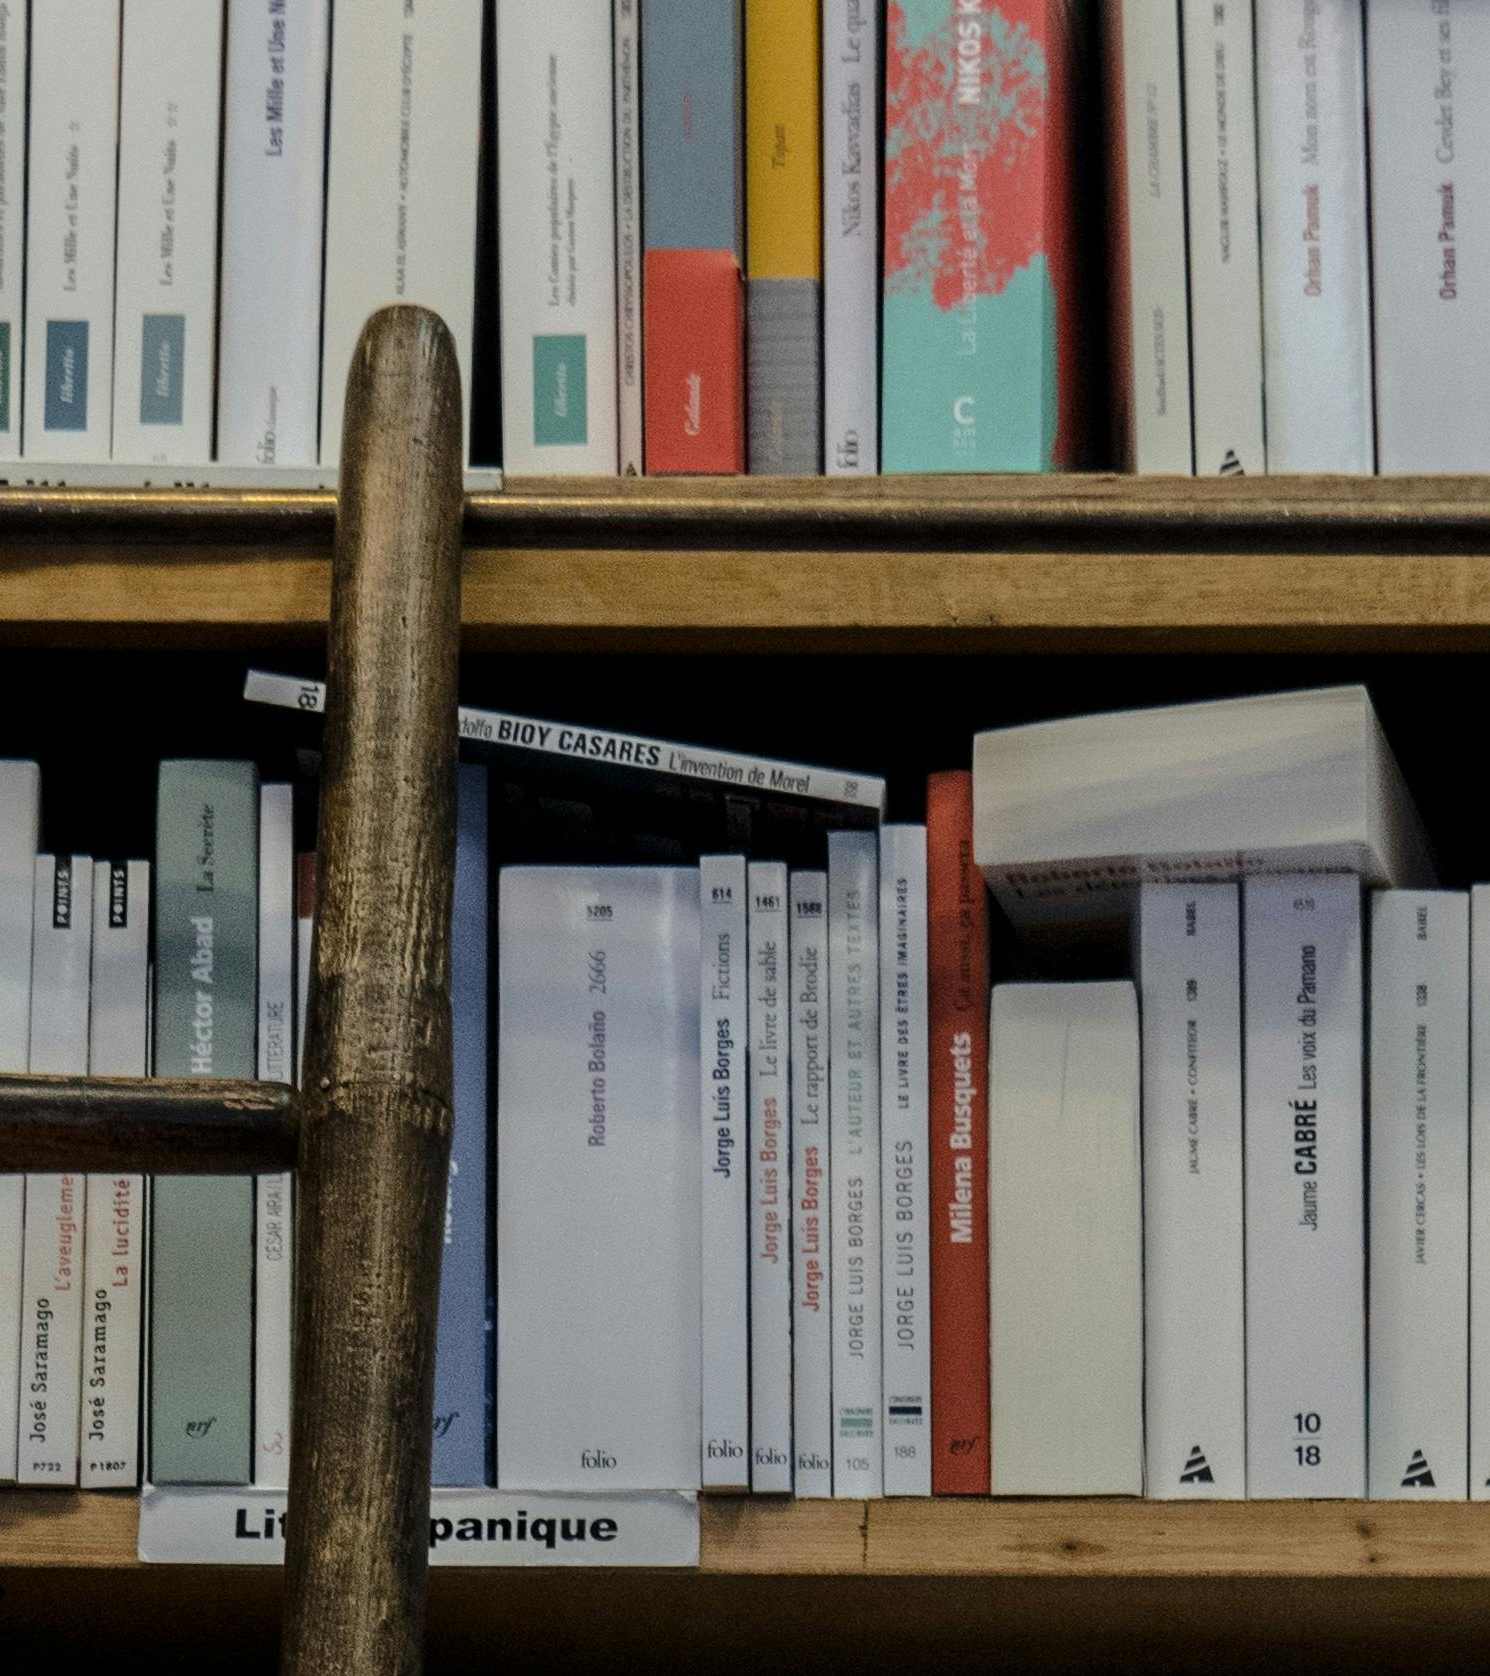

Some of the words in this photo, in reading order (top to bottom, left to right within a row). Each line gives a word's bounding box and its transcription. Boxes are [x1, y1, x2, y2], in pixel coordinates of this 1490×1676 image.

[1436, 181, 1456, 243] Pamuk
[1437, 245, 1458, 301] Orhan
[496, 718, 552, 748] BIOY
[557, 729, 661, 767] CASARES
[188, 914, 215, 985] Abad
[587, 948, 607, 996] 2666
[710, 932, 731, 1001] Fictions
[1295, 943, 1317, 1005] Pamano
[189, 988, 214, 1075] Héctor
[586, 1007, 608, 1074] Bolaño
[710, 1016, 735, 1081] Borges
[1296, 1007, 1318, 1028] du
[1301, 1030, 1318, 1061] voix
[711, 1084, 732, 1123] Luis
[948, 1030, 978, 1150] Busquets
[1297, 1063, 1318, 1090] Les
[586, 1075, 607, 1148] Roberto
[1292, 1098, 1318, 1176] CABRÉ
[711, 1125, 736, 1180] Jorge
[947, 1154, 973, 1244] Milena
[1298, 1179, 1319, 1232] Jaume
[29, 1296, 55, 1394] Saramago
[27, 1399, 48, 1444] José
[427, 1509, 619, 1550] panique
